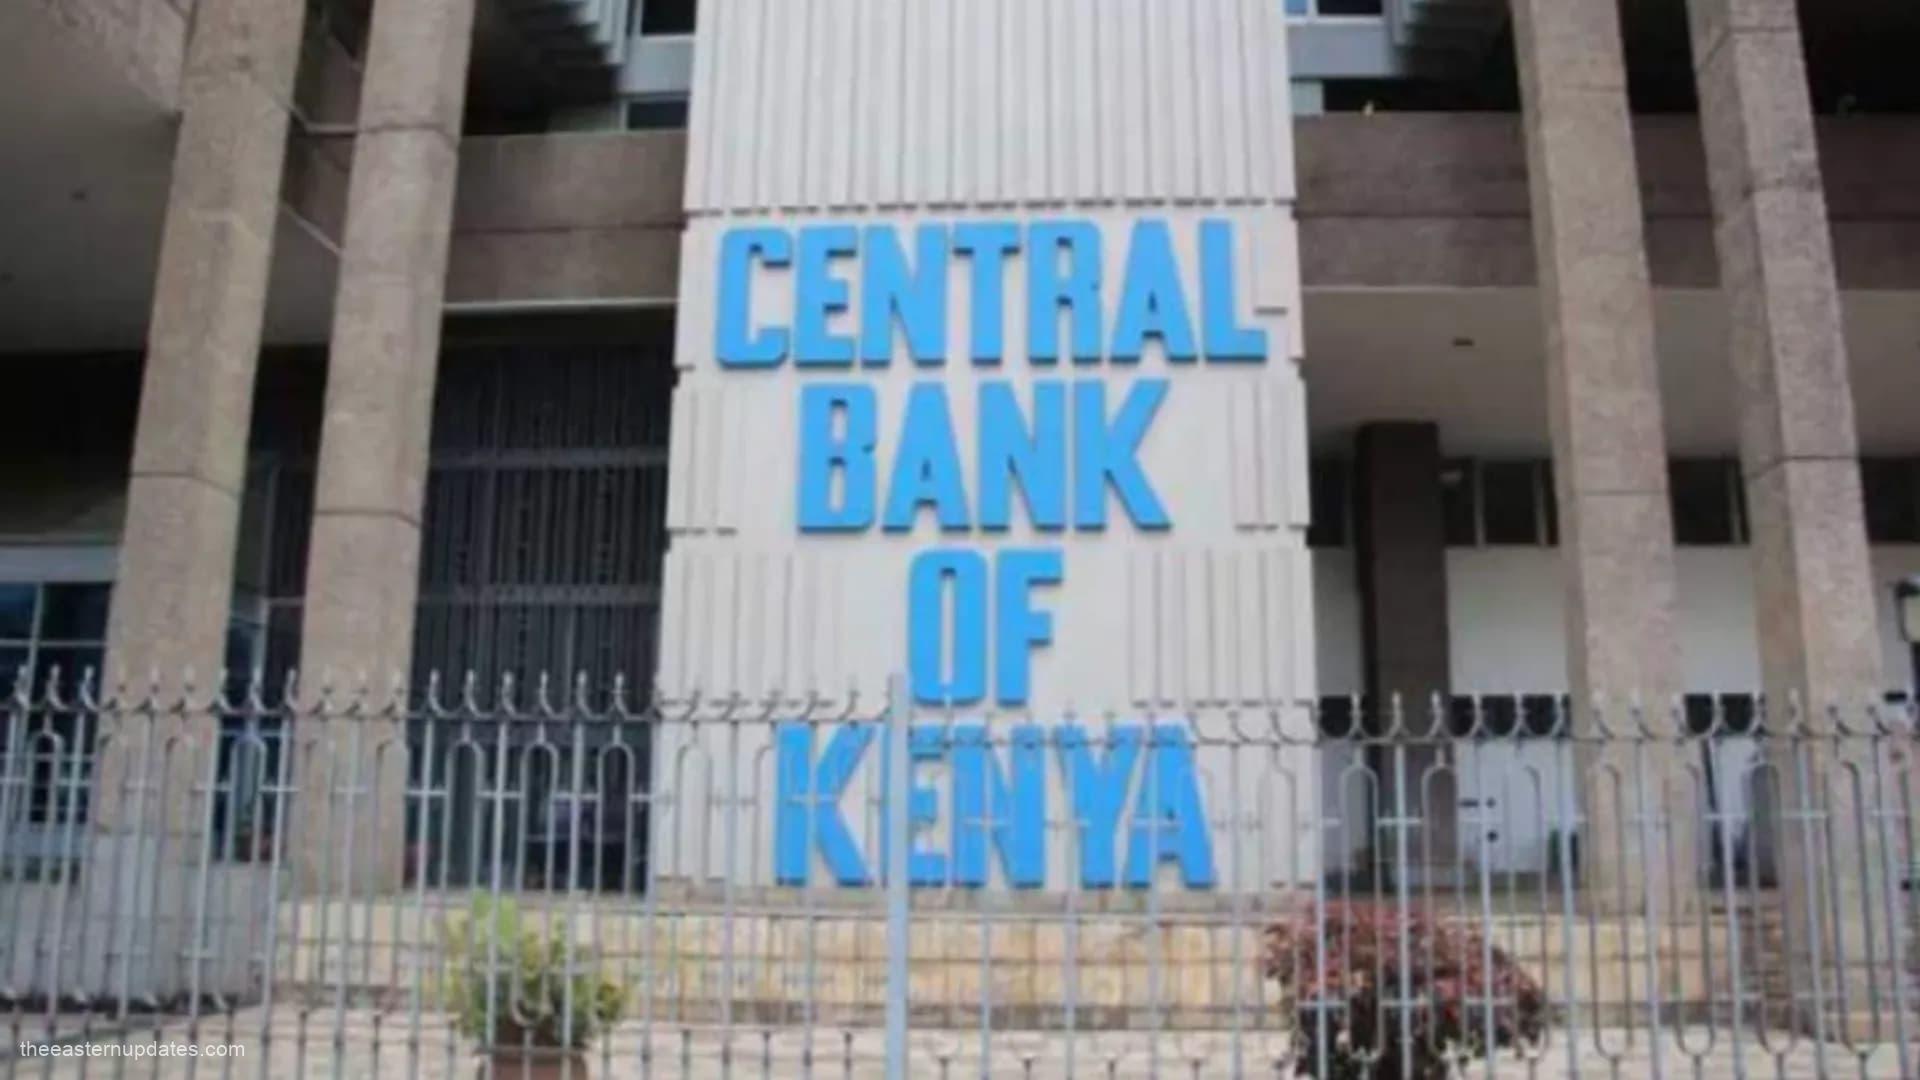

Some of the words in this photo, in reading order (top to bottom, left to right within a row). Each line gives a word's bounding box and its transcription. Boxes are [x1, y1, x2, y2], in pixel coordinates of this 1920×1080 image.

[715, 219, 1267, 367] CENTRAL
[798, 379, 1172, 532] BANK
[909, 549, 1064, 706] OF
[775, 724, 1215, 888] KENYA
